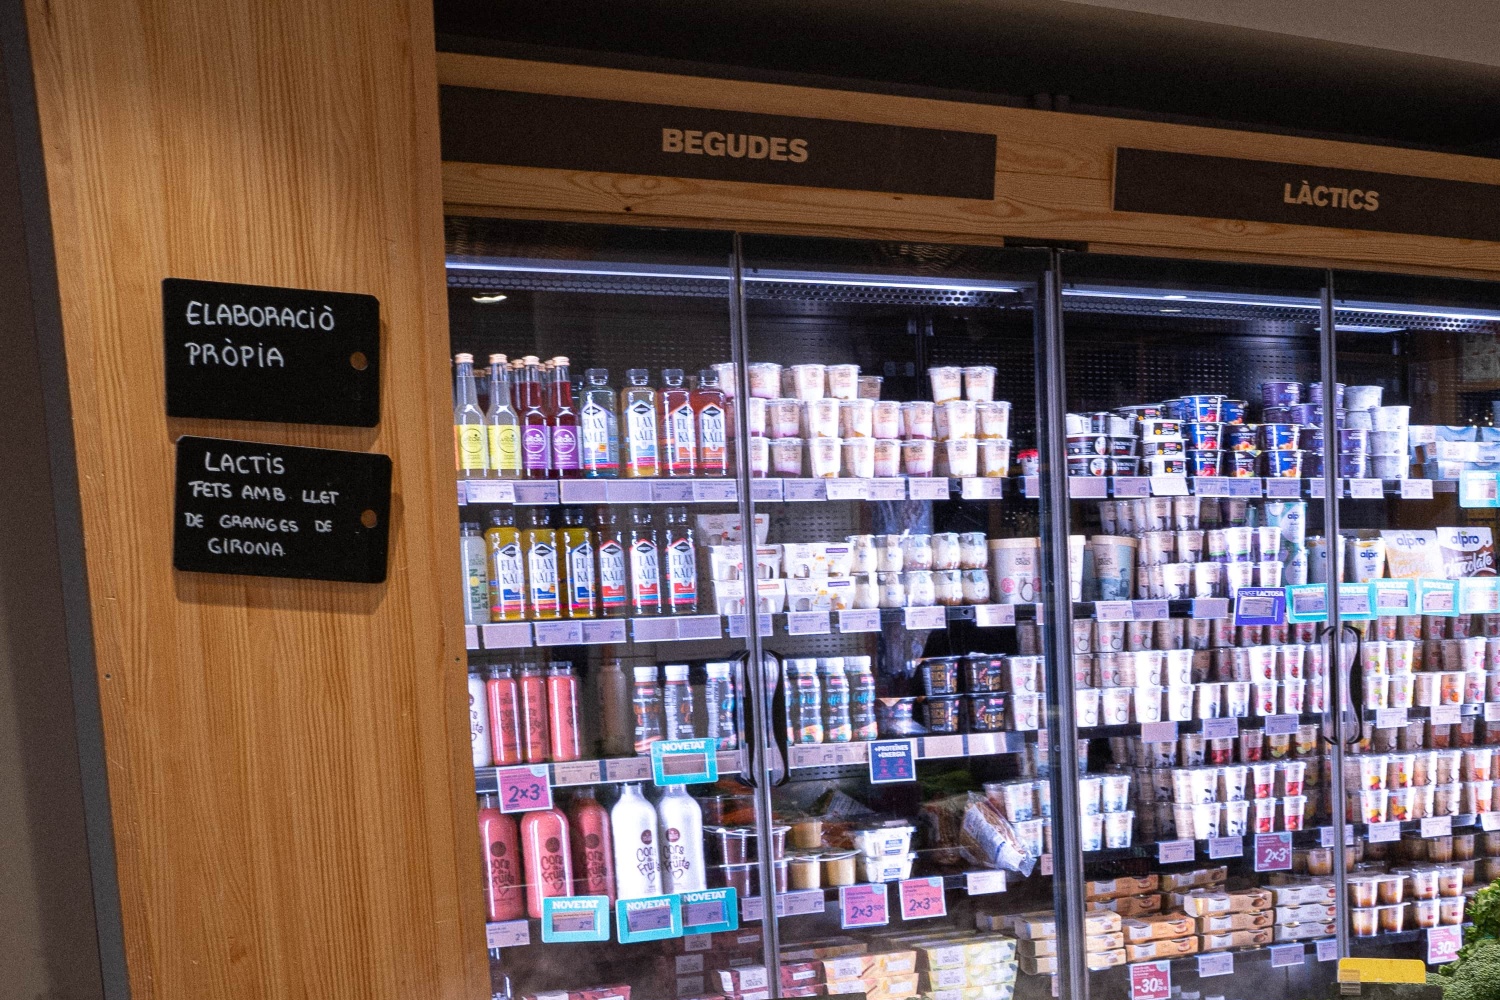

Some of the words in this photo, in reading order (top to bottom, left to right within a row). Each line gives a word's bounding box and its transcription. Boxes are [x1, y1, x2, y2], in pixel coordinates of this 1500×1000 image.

[661, 128, 808, 164] BEGUDES
[1284, 180, 1379, 212] LÀCTICS
[184, 338, 285, 368] PRÒPIA
[204, 451, 285, 475] LACTIS
[188, 480, 232, 498] FETS
[301, 489, 339, 505] LLET
[184, 512, 204, 529] DE
[219, 514, 299, 533] GRANGES
[315, 520, 332, 533] DE
[207, 537, 286, 557] GIRONA
[1396, 535, 1426, 549] alpro
[1451, 532, 1480, 547] alpro
[661, 740, 706, 752] NOVETAT
[552, 899, 599, 910] NOVETAT
[625, 898, 671, 911] NOVETAT
[683, 890, 727, 903] NOVETAT
